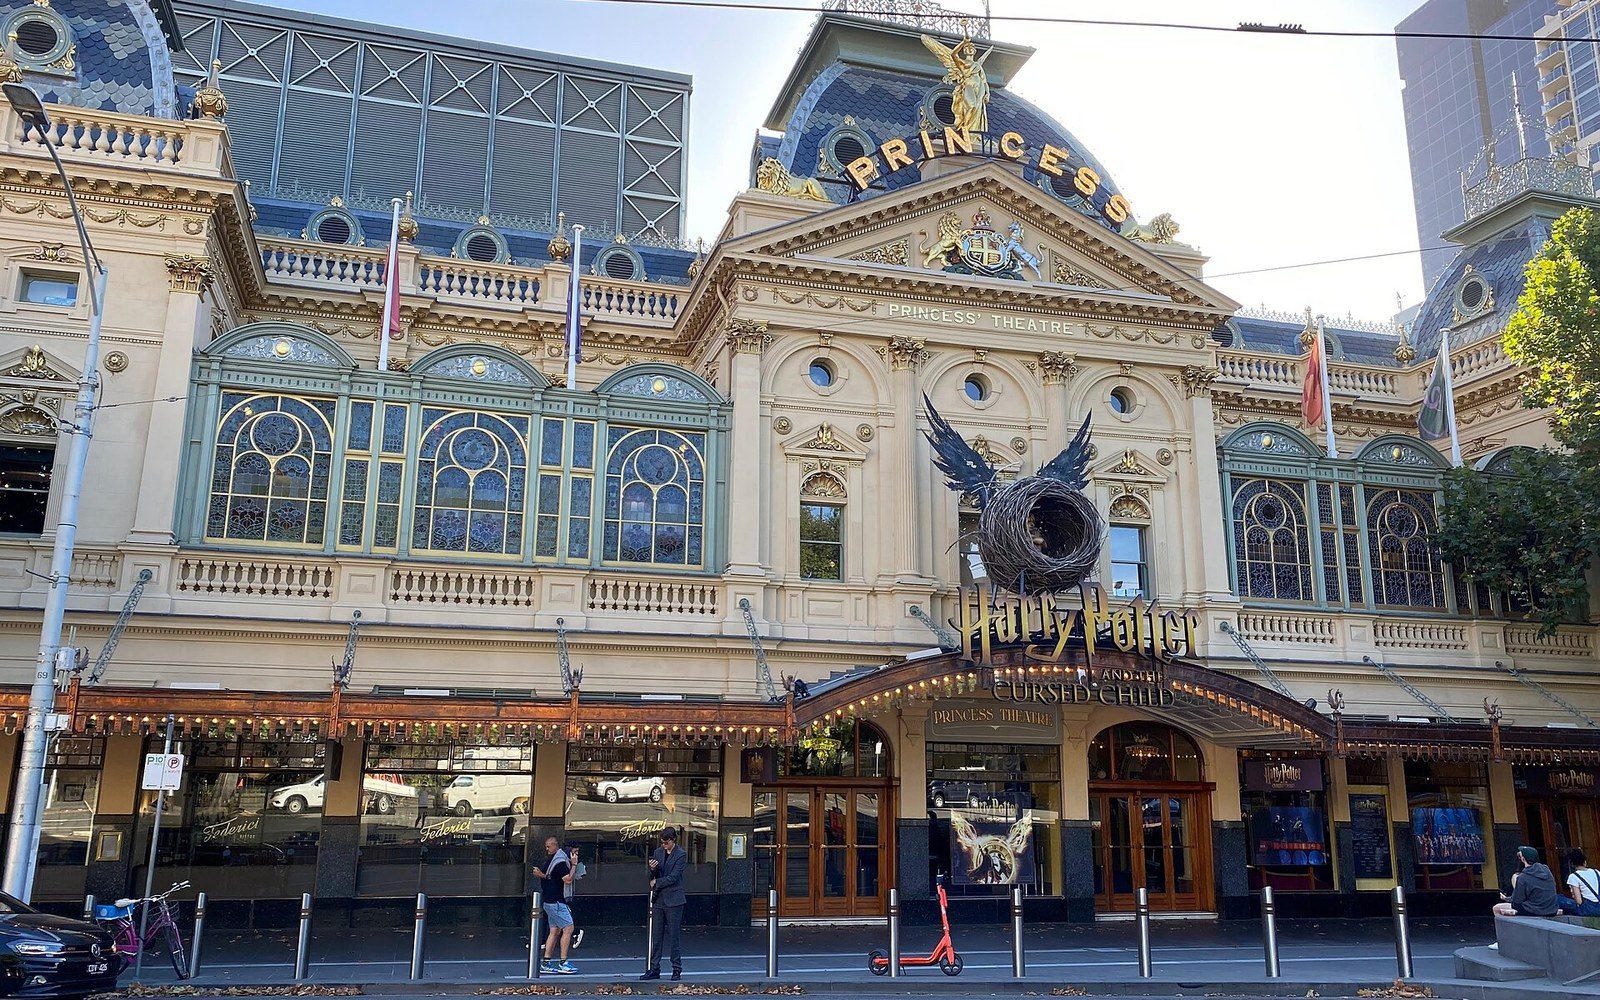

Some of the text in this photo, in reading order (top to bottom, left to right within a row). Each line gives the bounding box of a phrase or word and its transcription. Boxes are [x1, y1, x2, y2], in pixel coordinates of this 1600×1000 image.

[845, 126, 1131, 223] PRINCESS
[889, 304, 1074, 334] PRINCESS' THEATRE
[948, 579, 1201, 674] Harry Potter
[36, 671, 49, 679] 69
[992, 680, 1175, 707] CURSED CHILD
[934, 708, 994, 724] PRINCESS
[203, 816, 260, 842] Federici
[420, 817, 472, 842] Federici
[620, 818, 667, 842] Federici
